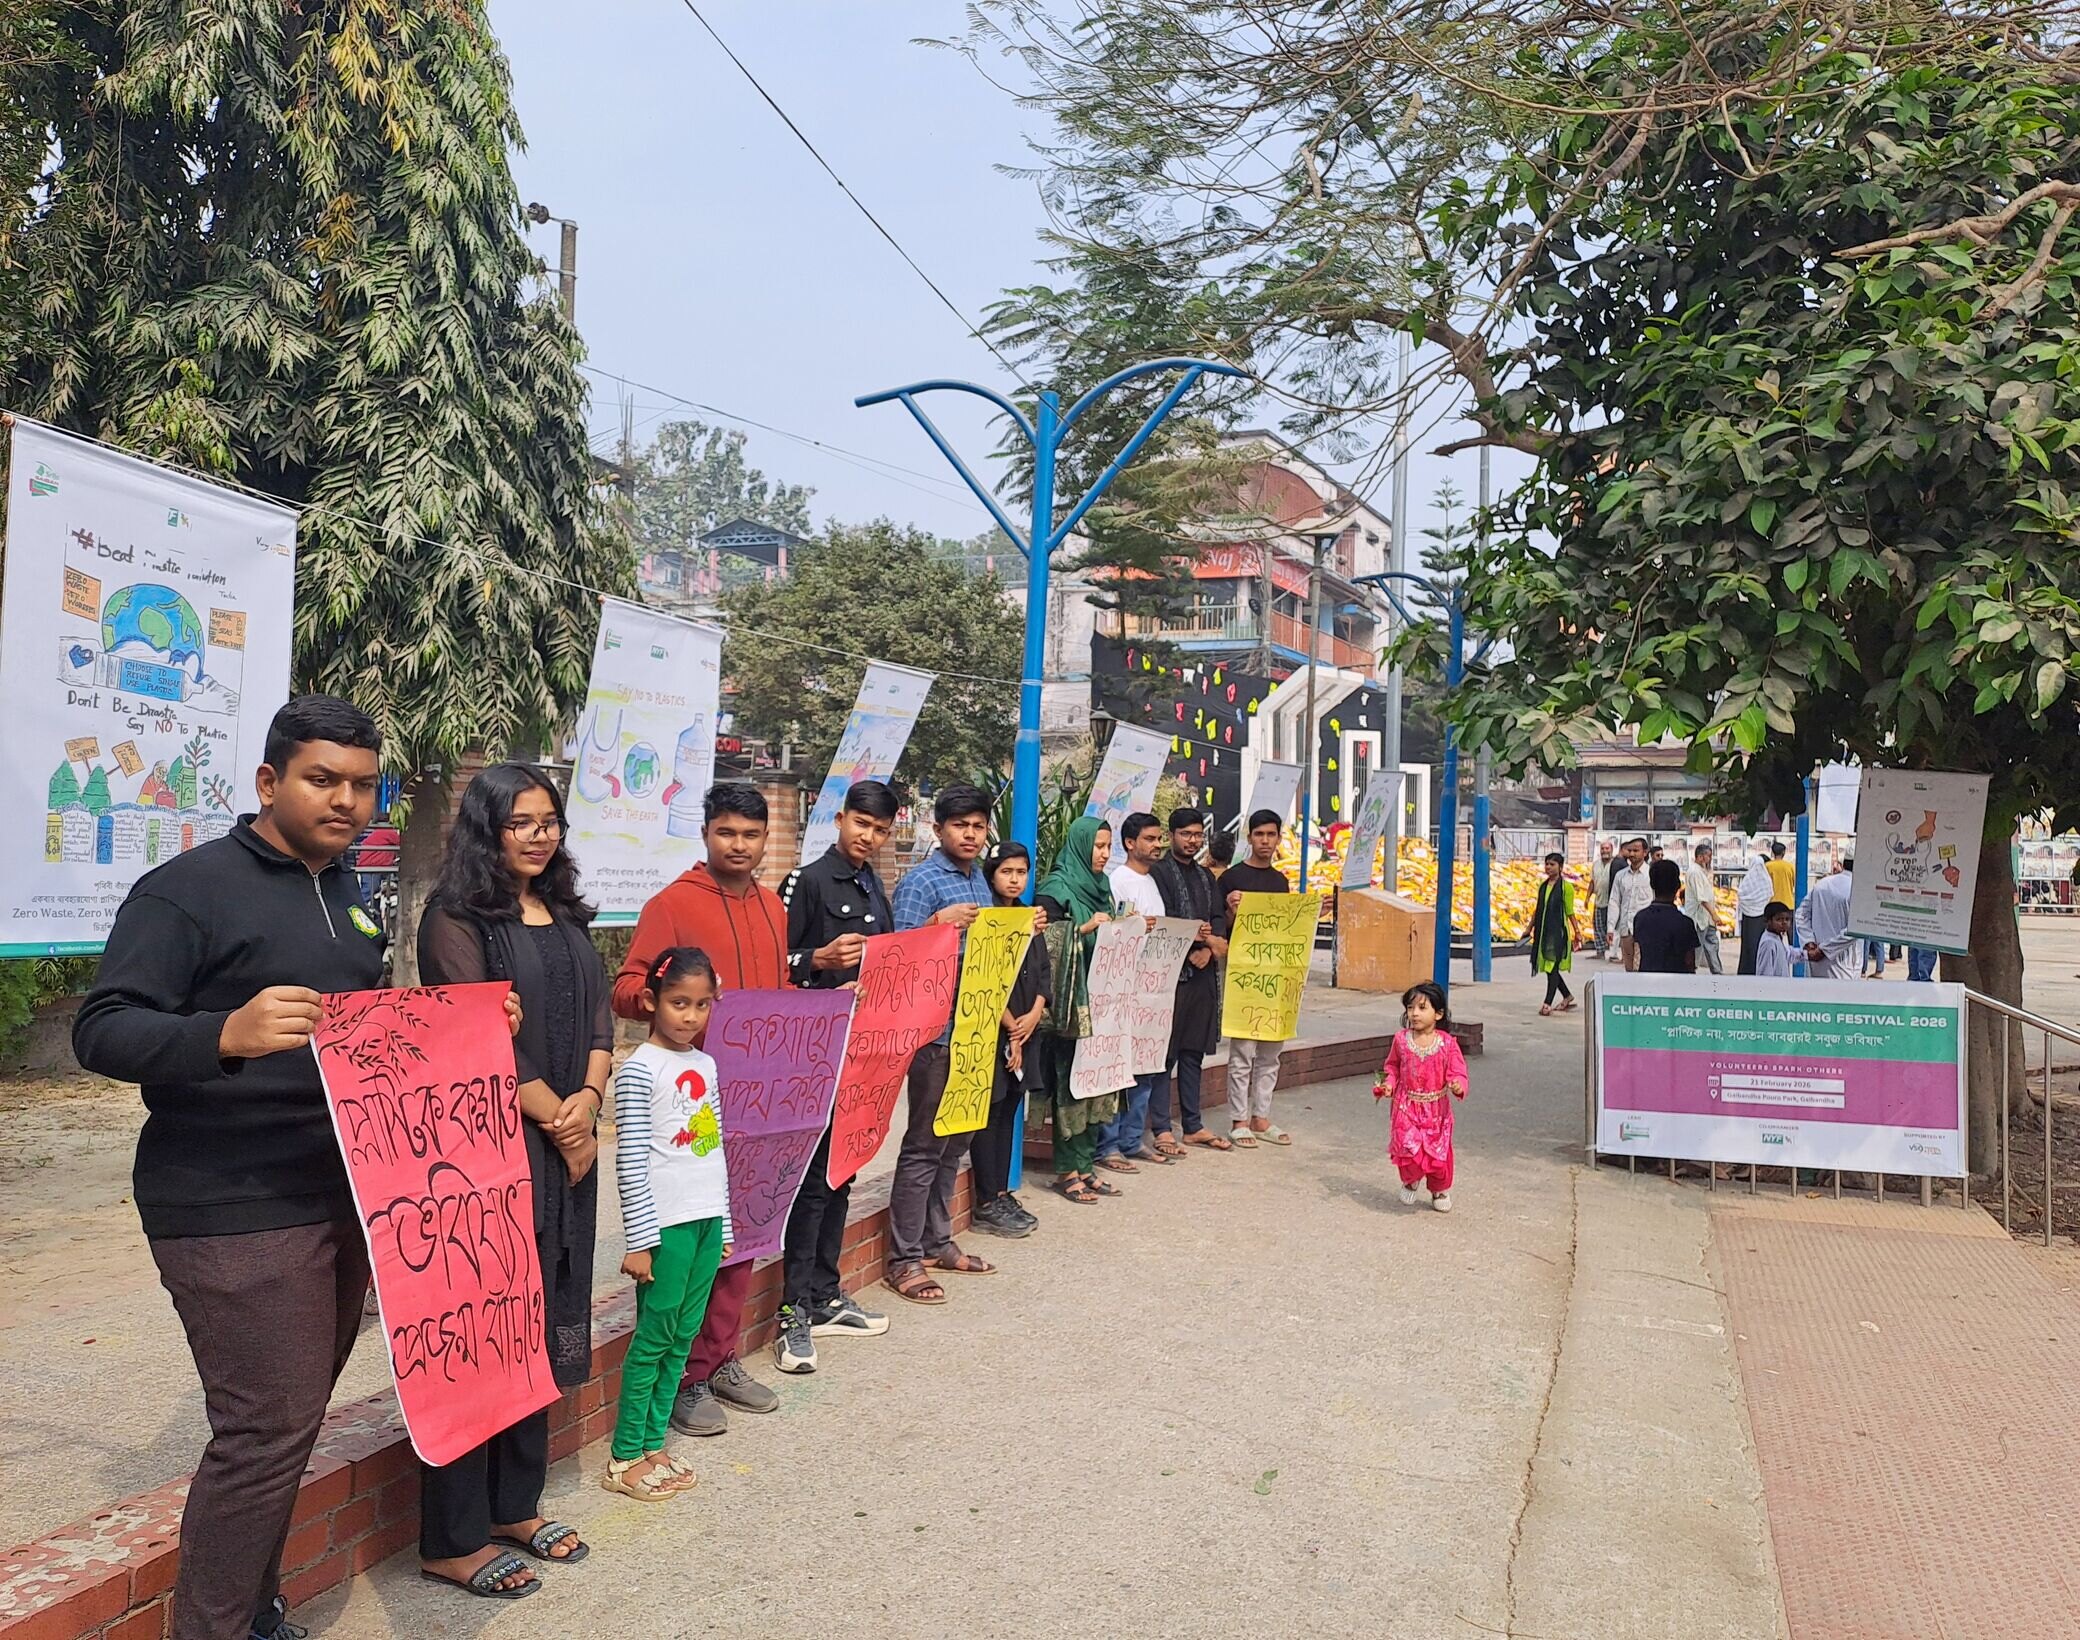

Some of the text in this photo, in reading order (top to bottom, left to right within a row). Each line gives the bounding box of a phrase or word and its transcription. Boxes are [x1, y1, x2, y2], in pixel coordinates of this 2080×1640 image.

[67, 690, 99, 709] Don't
[113, 697, 131, 713] Be
[126, 717, 144, 735] Say
[155, 720, 173, 733] NO
[177, 723, 188, 735] To
[601, 805, 622, 820] SAVE
[13, 908, 38, 918] Zero
[41, 908, 75, 919] Waste,
[78, 908, 101, 918] Zero
[1612, 1004, 1947, 1028] CLIMATE ART GREEN LEARNING FESTIVAL 2026
[1728, 1030, 1764, 1041] সচেতন
[1767, 1031, 1812, 1045] ব্যবহারই
[1815, 1035, 1841, 1048] সবুজ
[1710, 1062, 1843, 1075] VOLUNTEERS SPARK OTHERS
[1760, 1079, 1792, 1089] February
[1793, 1080, 1811, 1088] 2026
